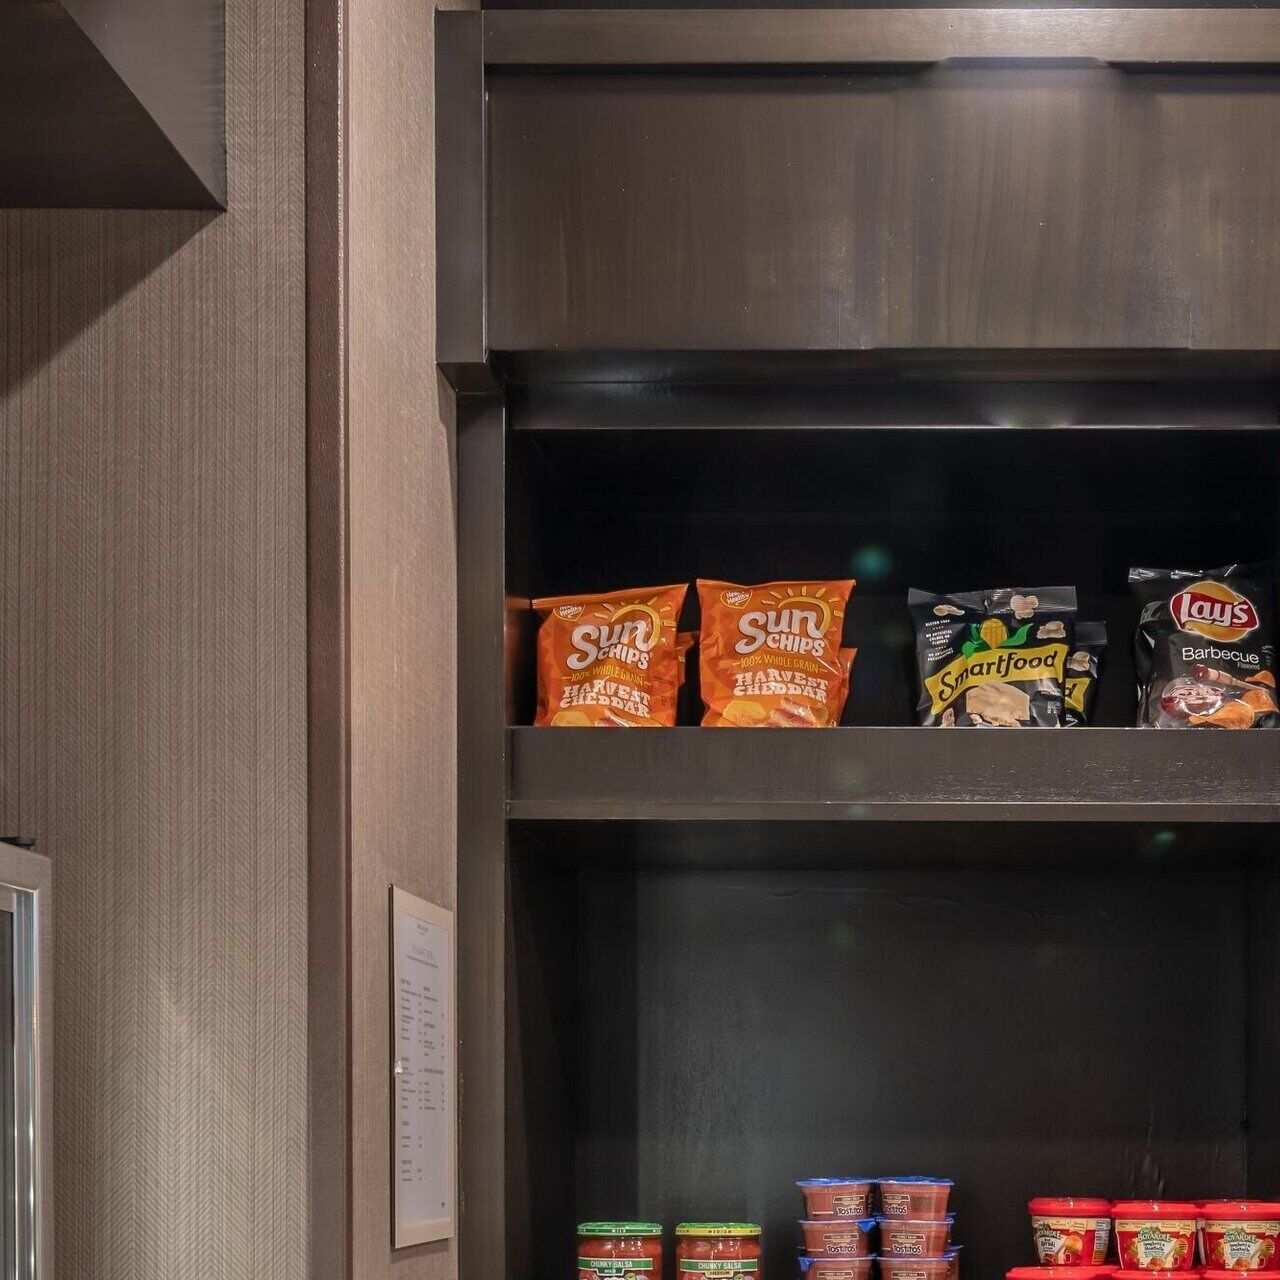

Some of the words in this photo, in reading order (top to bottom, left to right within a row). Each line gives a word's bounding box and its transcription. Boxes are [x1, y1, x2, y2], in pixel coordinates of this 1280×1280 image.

[1180, 592, 1250, 628] Lay's
[734, 608, 824, 655] Sun
[566, 619, 652, 671] Sun
[597, 644, 650, 670] CHIPS
[765, 633, 826, 657] CHIPS
[1181, 645, 1260, 665] Barbecue
[740, 655, 762, 668] 100%
[764, 654, 793, 666] WHOLE
[793, 659, 820, 674] GRAIN
[937, 649, 1060, 703] Smartfood
[592, 667, 620, 679] WHOLE
[620, 668, 645, 686] GRAIN
[736, 667, 829, 690] HARVEST
[562, 679, 651, 706] HARVEST
[733, 682, 828, 704] CHEDDAR
[559, 693, 651, 719] CHEDDAR
[590, 1260, 613, 1268] CHUNKY
[614, 1260, 634, 1269] SALSA
[697, 1261, 721, 1269] CHUNKY
[722, 1261, 742, 1270] SALSA
